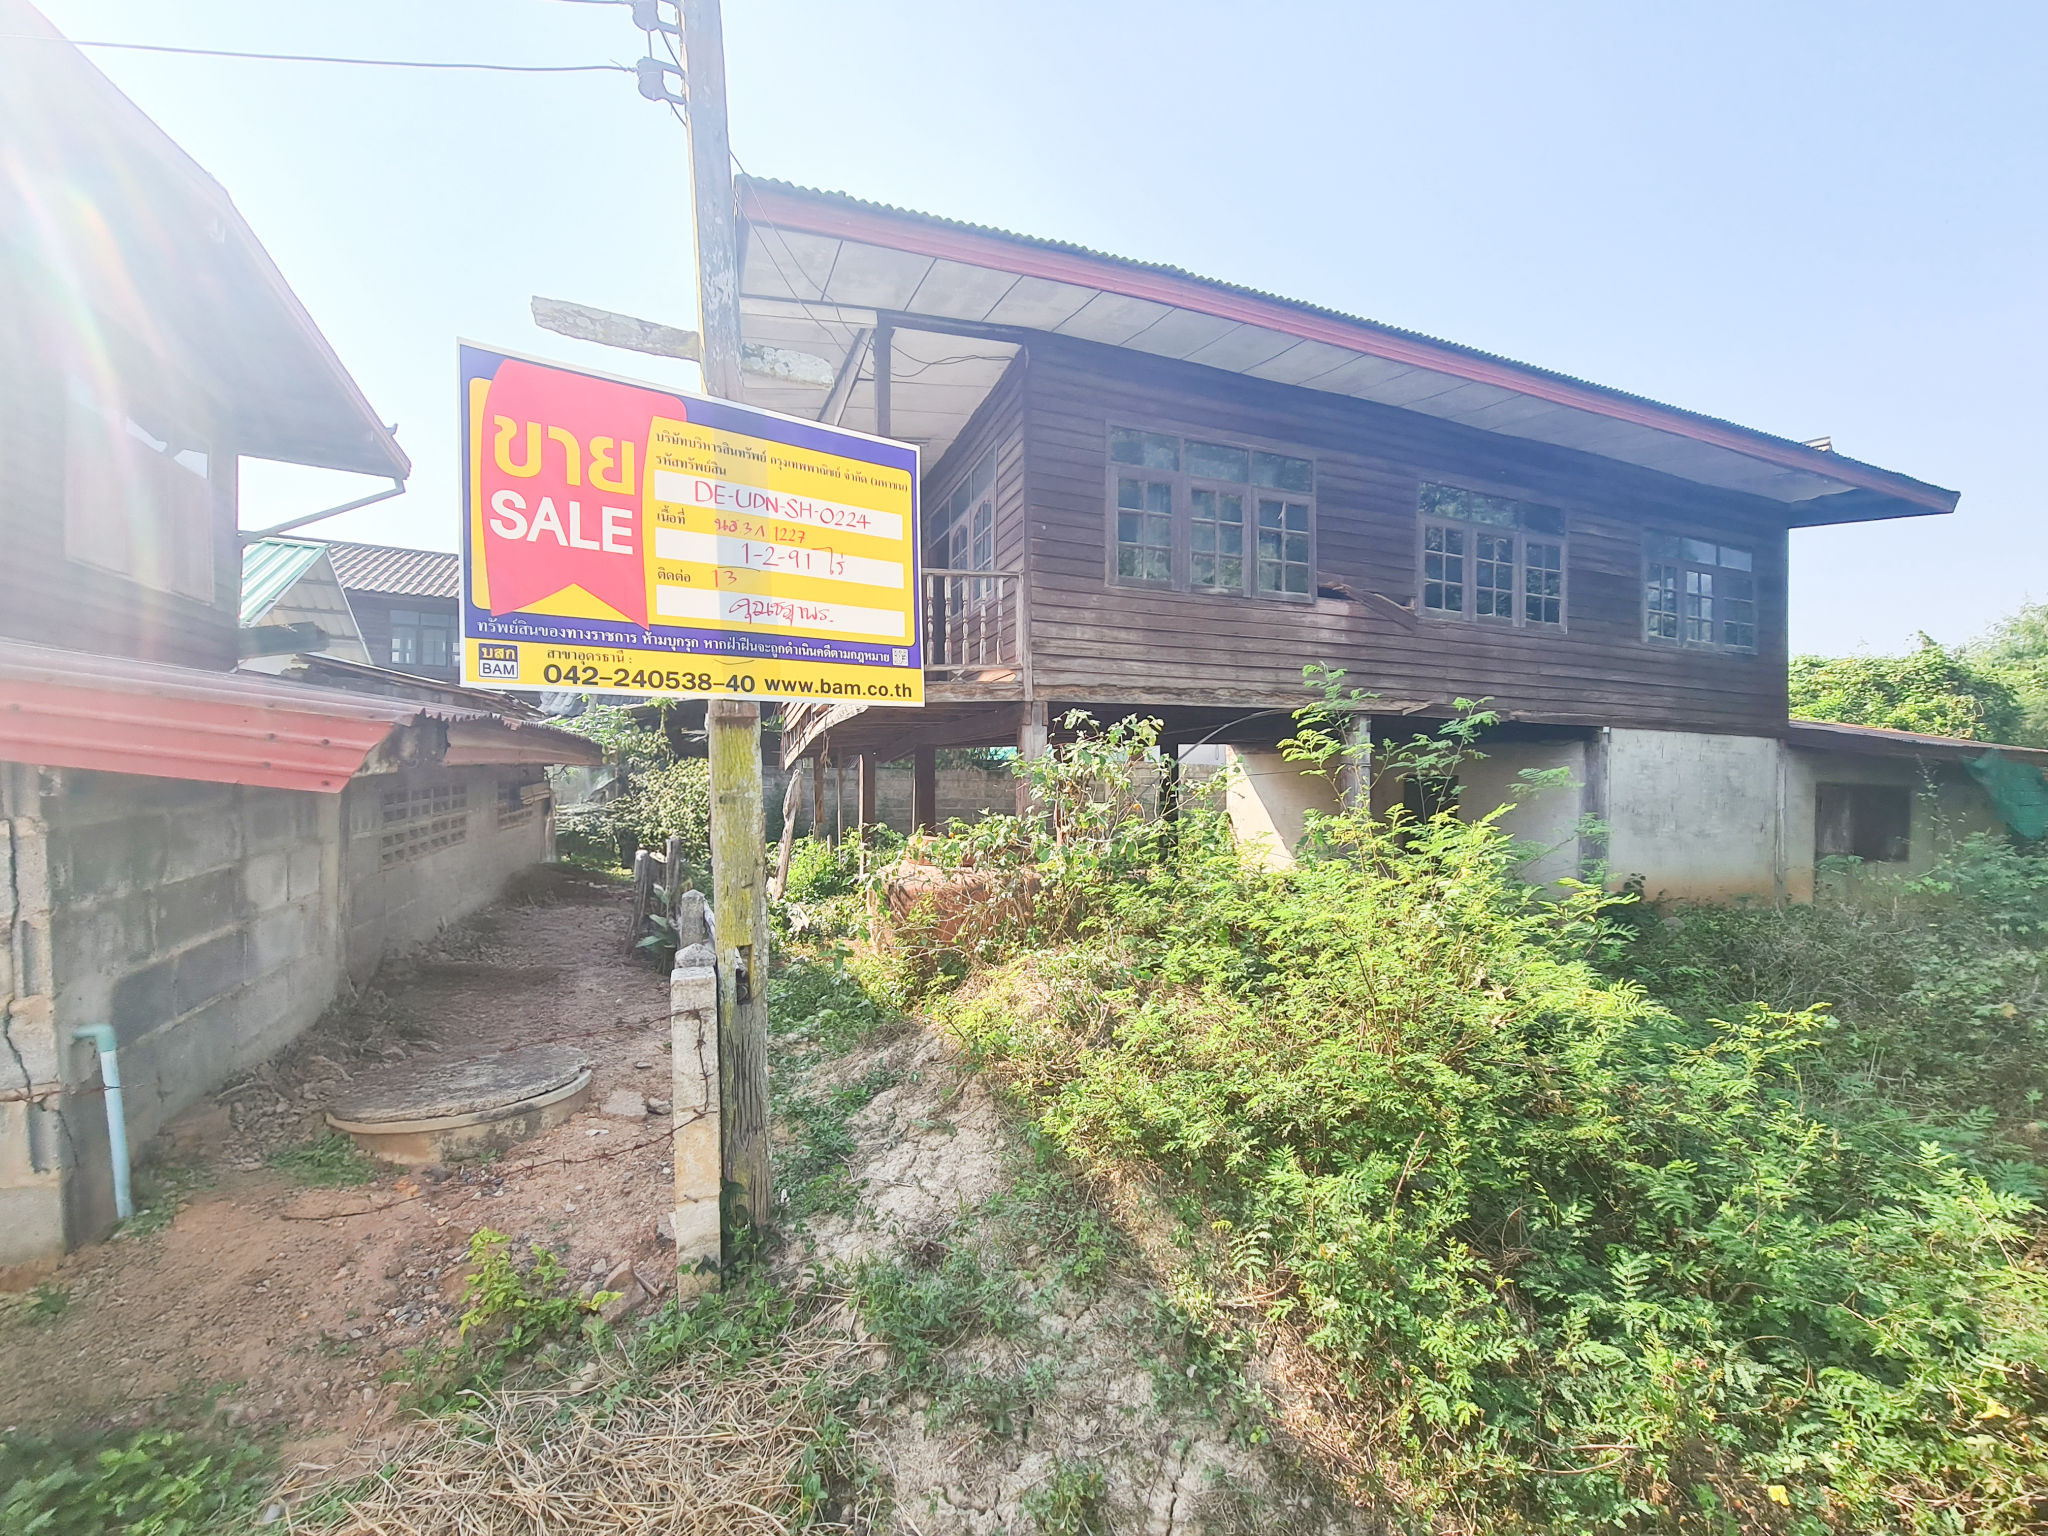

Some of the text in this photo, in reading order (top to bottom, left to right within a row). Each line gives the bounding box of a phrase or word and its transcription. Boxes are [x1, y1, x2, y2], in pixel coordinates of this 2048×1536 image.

[493, 414, 636, 496] ขาย
[656, 429, 767, 463] บริษัทบริหารสินทรัพย์
[655, 452, 727, 476] รหัสทรัพย์สิน
[657, 504, 686, 526] เนื้อที่
[694, 480, 872, 530] DE-UDN-SH-0224
[489, 489, 634, 555] SALE
[774, 526, 806, 544] 1227
[657, 566, 691, 583] ติดต่อ
[476, 617, 890, 664] ทรัพย์สินของทางราชการ ห้ามบุกรุก หากฝ่าฝืนจะถูกดำเนินคดีตามกฎหมาย
[480, 645, 516, 660] บสก
[481, 662, 515, 676] BAM
[543, 663, 756, 693] 042-240538-40
[764, 677, 913, 699] www.bam.co.th
